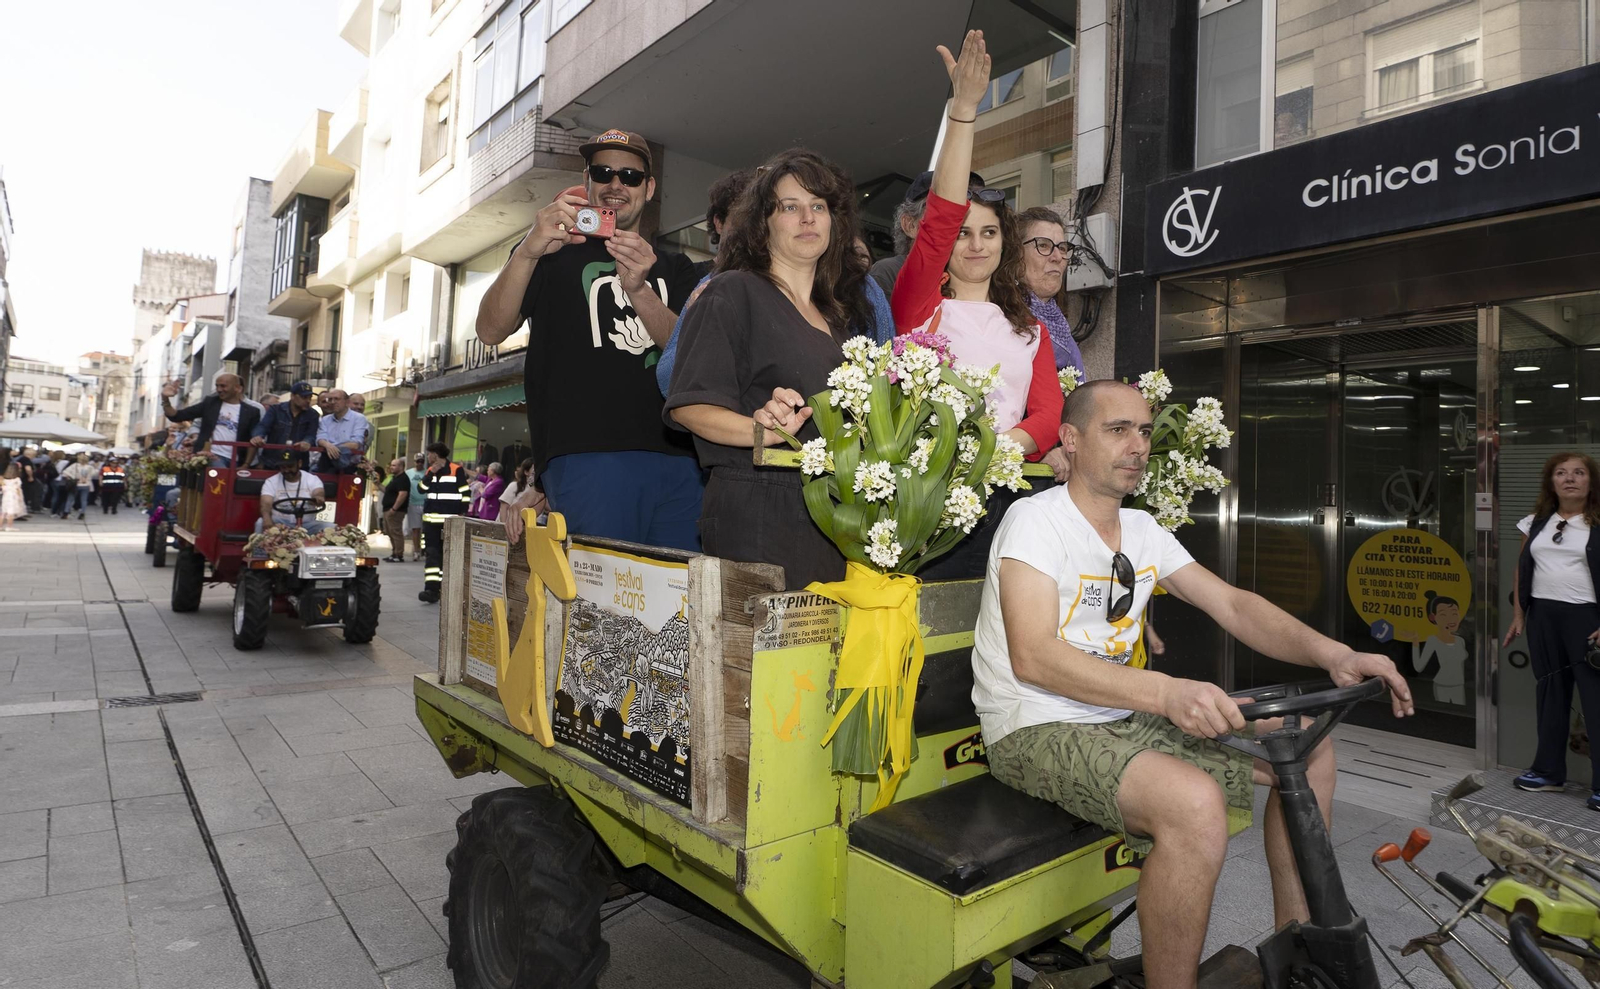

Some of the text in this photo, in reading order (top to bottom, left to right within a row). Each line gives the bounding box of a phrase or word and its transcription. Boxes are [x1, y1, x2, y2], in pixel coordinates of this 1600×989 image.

[600, 134, 626, 142] TOYOTA
[1302, 125, 1580, 208] Clínica Sonia
[1392, 535, 1421, 544] PARA
[1381, 544, 1433, 555] RESERVAR
[1365, 553, 1451, 566] CITA Y CONSULTA
[614, 567, 643, 591] festival
[1357, 566, 1460, 582] LLÁMANOS EN ESTE HORARIO
[1359, 578, 1367, 586] DE
[1370, 579, 1387, 588] 10:00
[1396, 581, 1414, 590] 14:00
[1372, 589, 1390, 598] 16:00
[1397, 591, 1416, 600] 20:00
[614, 590, 645, 617] de cans
[1362, 601, 1423, 618] 622 740 015
[793, 635, 831, 645] REDONDELA
